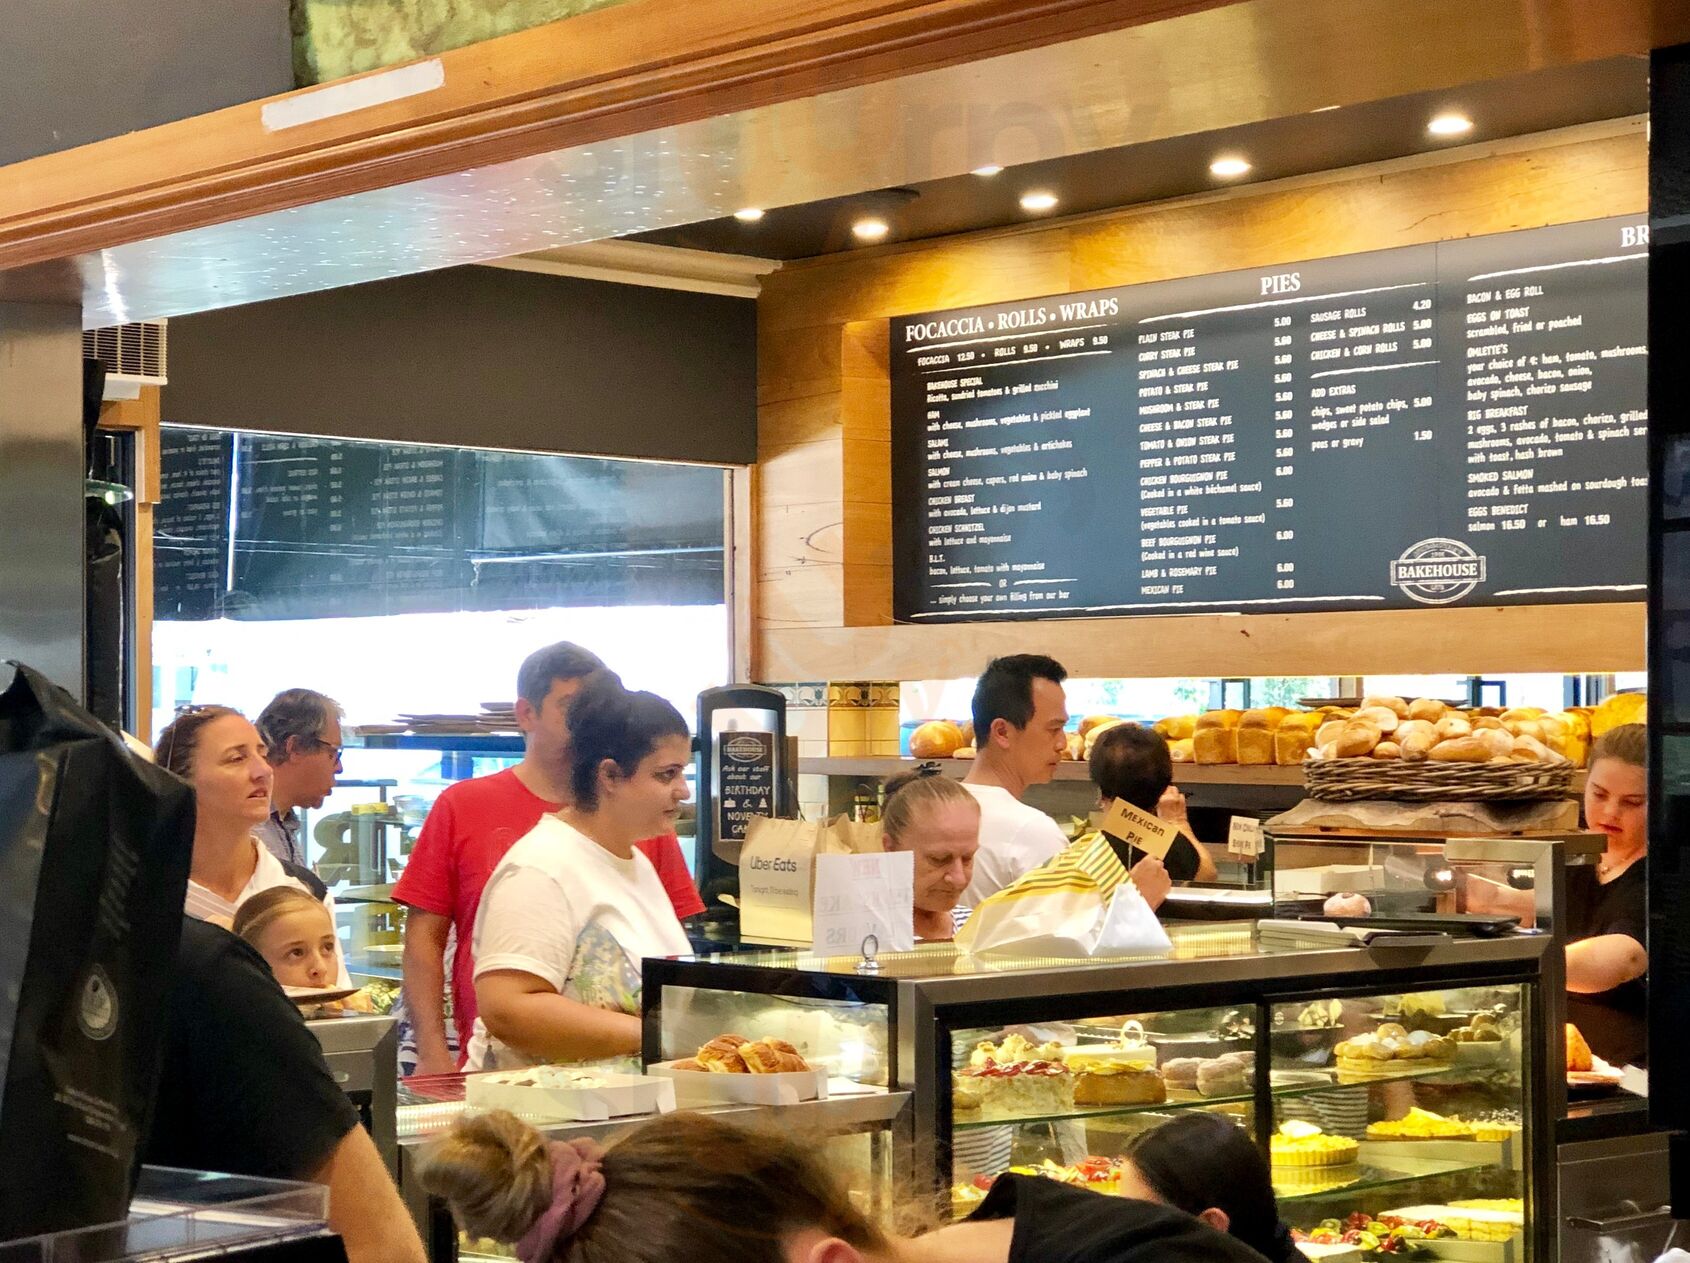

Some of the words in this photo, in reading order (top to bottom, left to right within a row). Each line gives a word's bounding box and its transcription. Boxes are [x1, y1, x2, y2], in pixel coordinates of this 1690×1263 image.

[1261, 273, 1300, 295] PIES
[1467, 292, 1491, 304] BACON
[1495, 291, 1501, 300] &
[1506, 288, 1520, 299] EGG
[1524, 286, 1543, 296] ROLL
[1413, 299, 1431, 310] 4.20
[906, 316, 985, 342] FOCACCIA
[998, 308, 1046, 330] ROLLS
[1059, 297, 1118, 321] WRAPS
[1311, 311, 1341, 322] SAUSAGE
[1345, 307, 1366, 318] ROLLS
[1467, 312, 1486, 323] EGGS
[1490, 310, 1501, 321] ON
[1505, 307, 1529, 319] TOAST
[1311, 330, 1336, 341] CHEESE
[1349, 325, 1379, 337] SPINACH
[1383, 322, 1405, 333] ROLLS
[1513, 321, 1532, 333] fried
[1536, 322, 1545, 330] or
[1549, 315, 1581, 331] poached
[1139, 333, 1157, 344] PLAIN
[1160, 331, 1180, 341] STEAK
[1183, 329, 1194, 338] PIE
[918, 355, 949, 366] FOCACCIA
[995, 347, 1015, 356] ROLLS
[1059, 338, 1084, 349] WRAPS
[1139, 351, 1158, 361] CURRY
[1161, 349, 1181, 359] STEAK
[1184, 347, 1195, 356] PIE
[1311, 348, 1341, 360] CHICKEN
[1344, 348, 1350, 356] &
[1353, 345, 1372, 355] CORN
[1375, 342, 1397, 353] ROLLS
[1139, 368, 1166, 379] SPINACH
[1177, 364, 1200, 375] CHEESE
[1203, 362, 1224, 372] STEAK
[1227, 360, 1239, 370] PIE
[1468, 363, 1485, 374] your
[1488, 359, 1513, 369] choice
[1517, 356, 1526, 367] of
[1139, 386, 1162, 397] POTATO
[1165, 386, 1171, 394] &
[1174, 384, 1194, 393] STEAK
[1197, 382, 1208, 391] PIE
[1311, 388, 1326, 397] ADD
[1329, 385, 1356, 396] EXTRAS
[1467, 390, 1487, 401] baby
[1527, 383, 1556, 395] chorizo
[1560, 381, 1592, 392] sausage
[1139, 404, 1173, 415] MUSHROOM
[1176, 403, 1182, 411] &
[1184, 401, 1205, 410] STEAK
[1208, 399, 1219, 408] PIE
[1336, 404, 1356, 414] sweet
[1359, 402, 1383, 414] potato
[1468, 410, 1481, 420] BIG
[1485, 406, 1528, 418] BREAKFAST
[1312, 420, 1337, 431] wedges
[1340, 420, 1349, 428] or
[1352, 417, 1366, 427] side
[1370, 414, 1389, 425] salad
[1510, 420, 1536, 431] rashes
[1540, 418, 1549, 428] of
[1620, 410, 1647, 423] grilled
[1414, 430, 1432, 440] 1.50
[1555, 431, 1583, 442] tomato
[1587, 430, 1594, 439] &
[1598, 426, 1629, 440] spinach
[1312, 441, 1328, 451] peas
[1343, 438, 1363, 448] gravy
[1468, 452, 1485, 463] with
[1515, 448, 1534, 459] hash
[1538, 448, 1563, 457] brown
[1468, 472, 1498, 483] SMOKED
[1502, 469, 1533, 480] SALMON
[1468, 486, 1499, 497] avocado
[1503, 486, 1509, 495] &
[1514, 484, 1533, 494] fetta
[1538, 481, 1567, 492] mashed
[1585, 477, 1627, 489] sourdough
[1468, 507, 1487, 517] EGGS
[1492, 504, 1528, 515] BENEDICT
[1468, 521, 1495, 531] salmon
[1561, 516, 1577, 526] ham
[1585, 515, 1610, 525] 16.50
[1142, 569, 1158, 578] LAMB
[1169, 567, 1202, 577] ROSEMARY
[1205, 566, 1216, 575] PIE
[1398, 563, 1478, 578] BAKEHOUSE
[1141, 585, 1169, 594] MEXICAN
[1172, 585, 1183, 594] PIE
[725, 786, 770, 795] BIRTHDAY
[742, 799, 752, 808] &
[728, 811, 768, 820] NOVE
[751, 856, 772, 870] Uber
[774, 858, 797, 872] Eats
